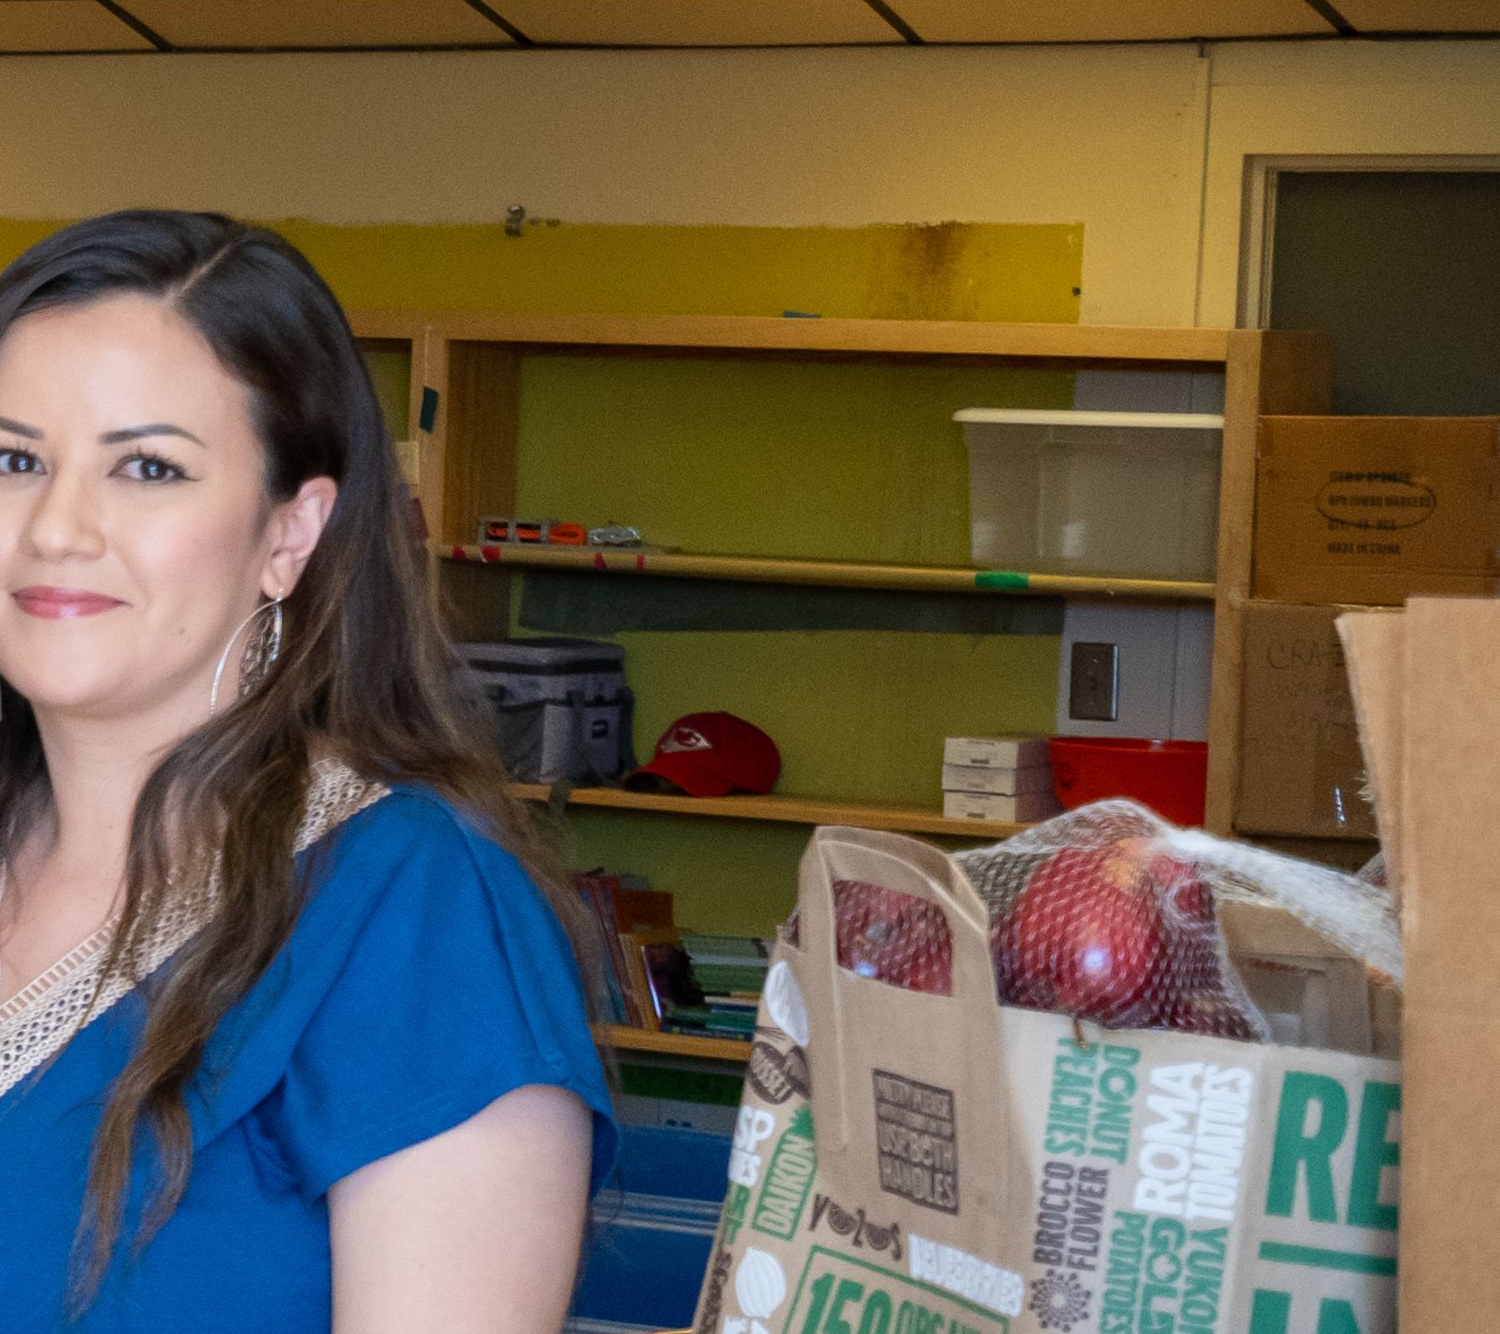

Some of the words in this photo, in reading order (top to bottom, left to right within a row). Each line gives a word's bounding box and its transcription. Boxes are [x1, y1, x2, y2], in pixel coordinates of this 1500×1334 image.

[1045, 1036, 1100, 1158] PEACHES
[1090, 1043, 1142, 1165] DONUT
[1133, 1062, 1205, 1216] ROMA
[1185, 1064, 1255, 1222] TOMATOES
[756, 1133, 814, 1235] DAIKON
[1032, 1161, 1076, 1267] BROCCO
[1068, 1166, 1110, 1271] FLOWER
